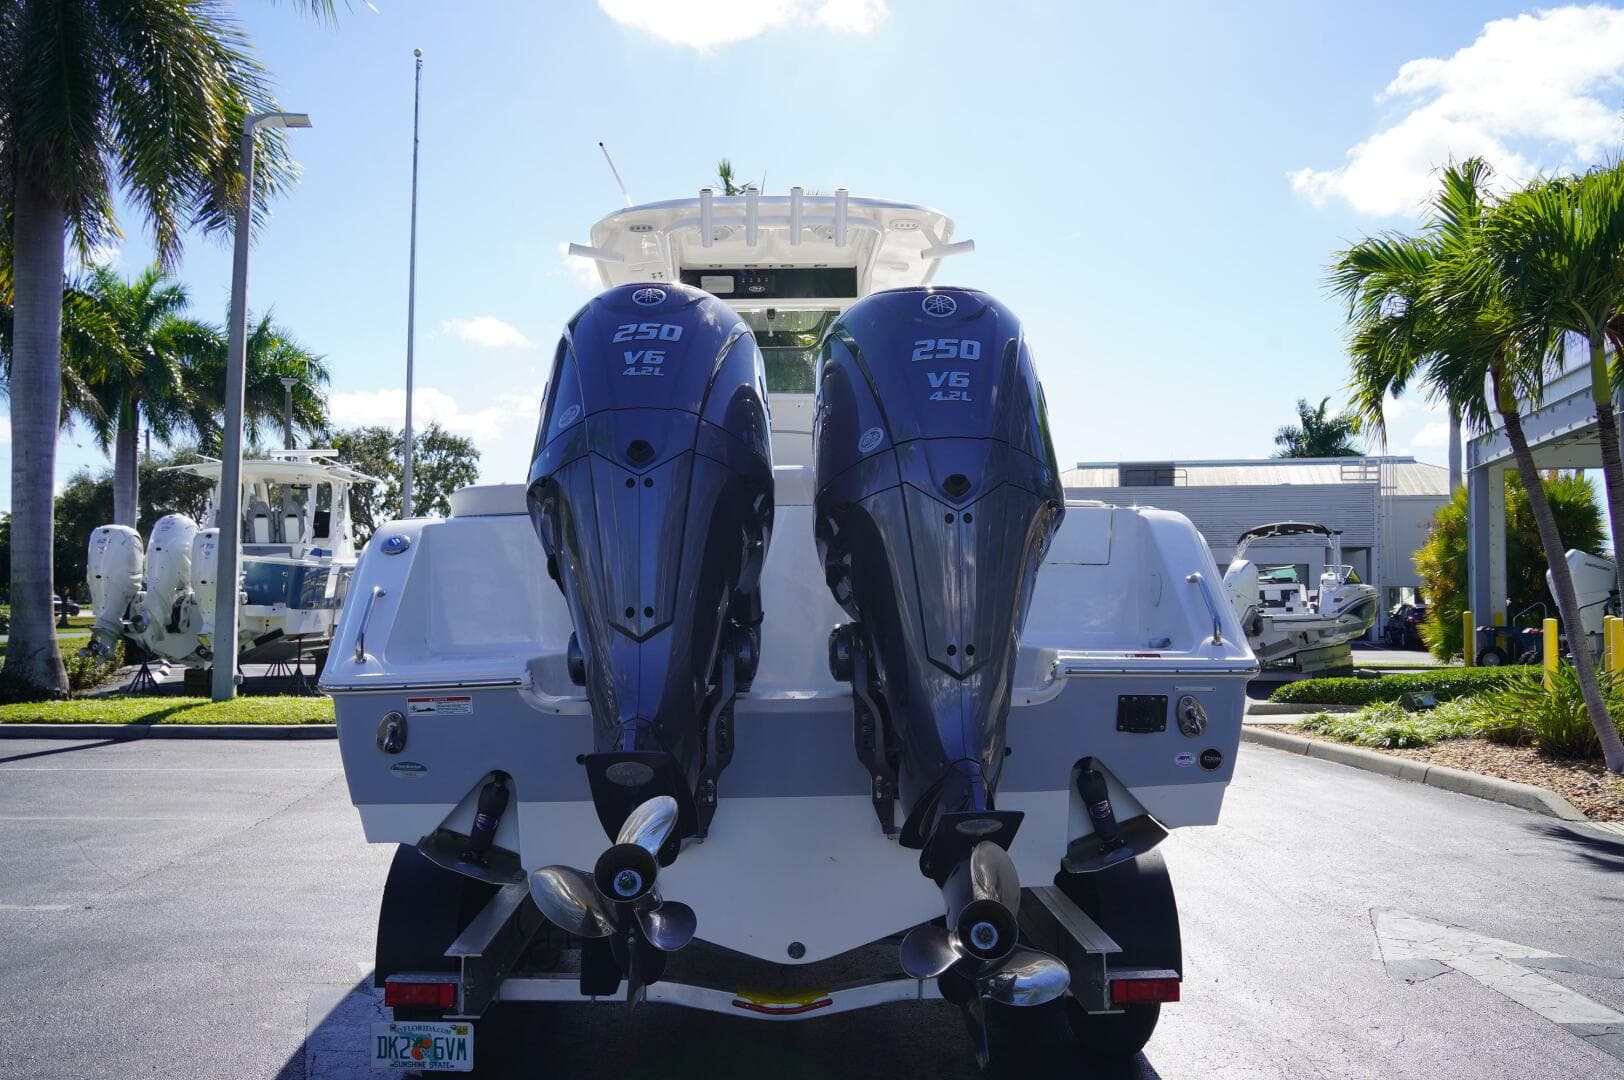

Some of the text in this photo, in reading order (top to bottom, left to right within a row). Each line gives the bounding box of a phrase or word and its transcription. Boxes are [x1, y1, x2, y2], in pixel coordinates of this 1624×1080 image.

[612, 323, 684, 344] 250
[623, 350, 666, 365] V6
[911, 338, 982, 362] 250
[622, 366, 665, 377] 4.2L
[926, 371, 971, 388] V6
[929, 390, 973, 402] 4.2L
[376, 1035, 467, 1061] DK2 6VM
[429, 1061, 450, 1069] STATE
